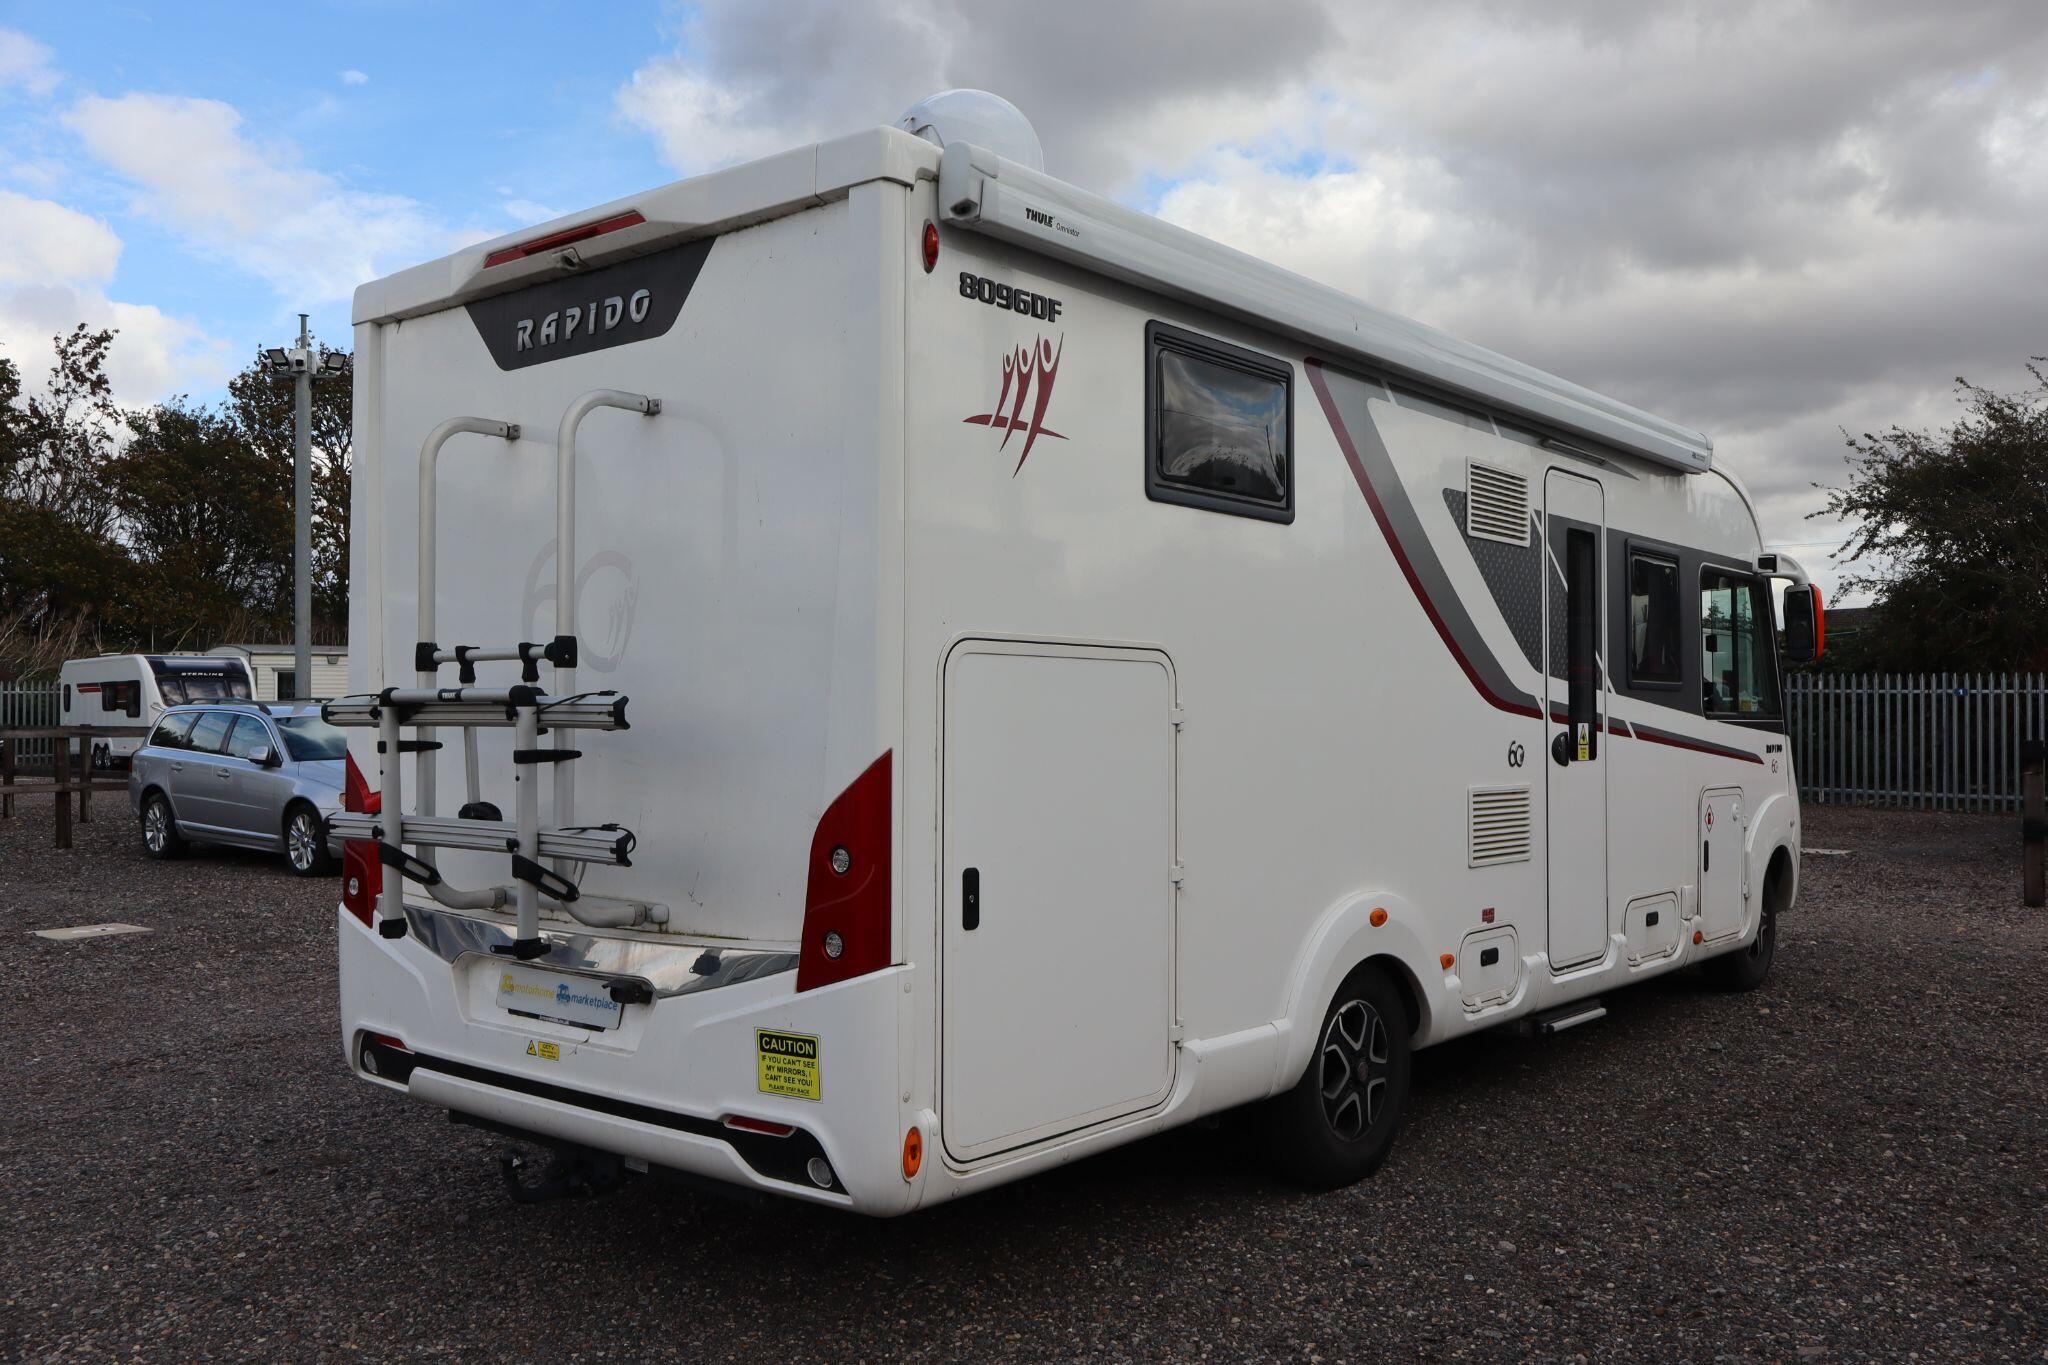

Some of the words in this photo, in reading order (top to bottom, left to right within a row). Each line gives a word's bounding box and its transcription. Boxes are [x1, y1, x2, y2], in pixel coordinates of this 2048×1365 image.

[1025, 207, 1054, 228] THULE
[1055, 222, 1080, 237] Omnistor
[959, 271, 1062, 323] 8096DF
[517, 288, 650, 352] RAPIDO
[514, 982, 555, 999] motorhome
[570, 994, 618, 1011] marketplace
[762, 1037, 813, 1055] CAUTION
[768, 1056, 781, 1064] YOU
[783, 1058, 801, 1067] CAN'T
[803, 1060, 816, 1069] SEE
[777, 1066, 808, 1077] MIRRORS,
[783, 1076, 796, 1084] SEE
[797, 1078, 813, 1087] YOU!
